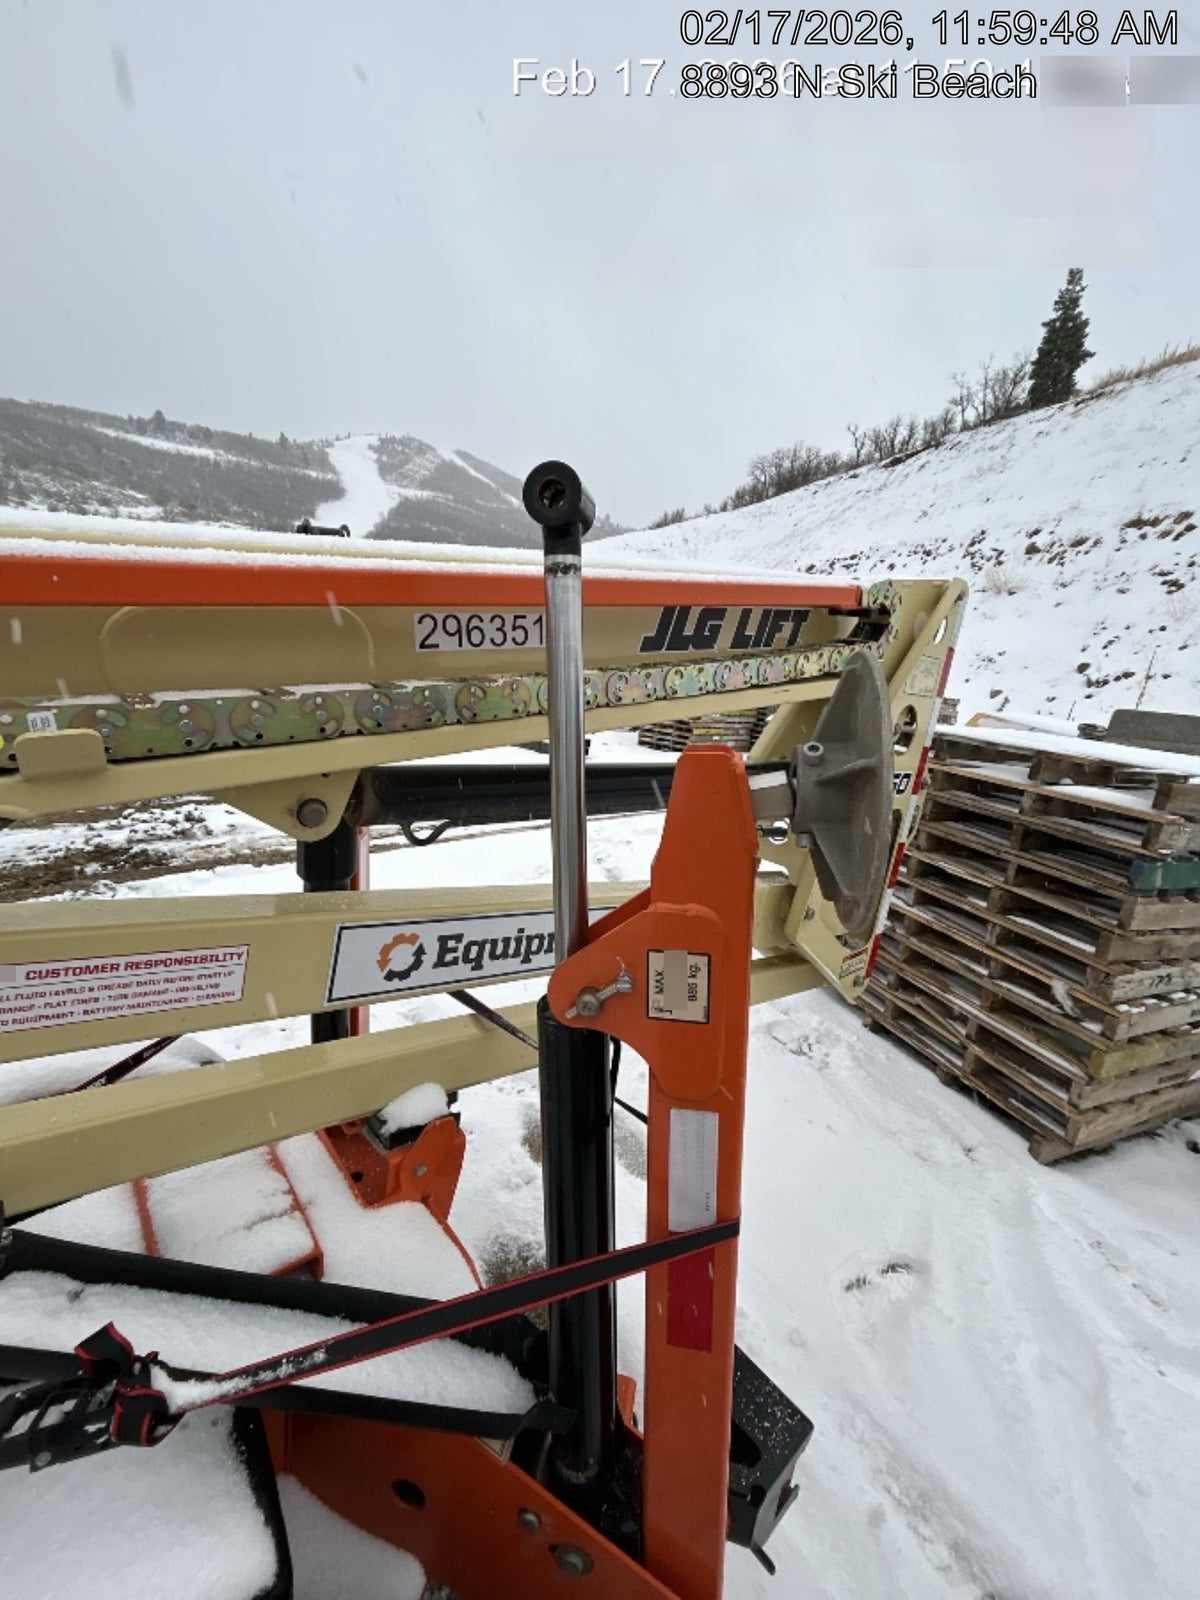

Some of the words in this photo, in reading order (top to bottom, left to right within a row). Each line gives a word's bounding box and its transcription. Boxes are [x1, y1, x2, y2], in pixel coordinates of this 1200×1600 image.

[417, 613, 543, 650] 296351
[638, 605, 728, 653] JLG
[729, 607, 812, 650] LIFT
[25, 962, 121, 981] CUSTOMER
[124, 951, 245, 972] RESPONSIBILITY
